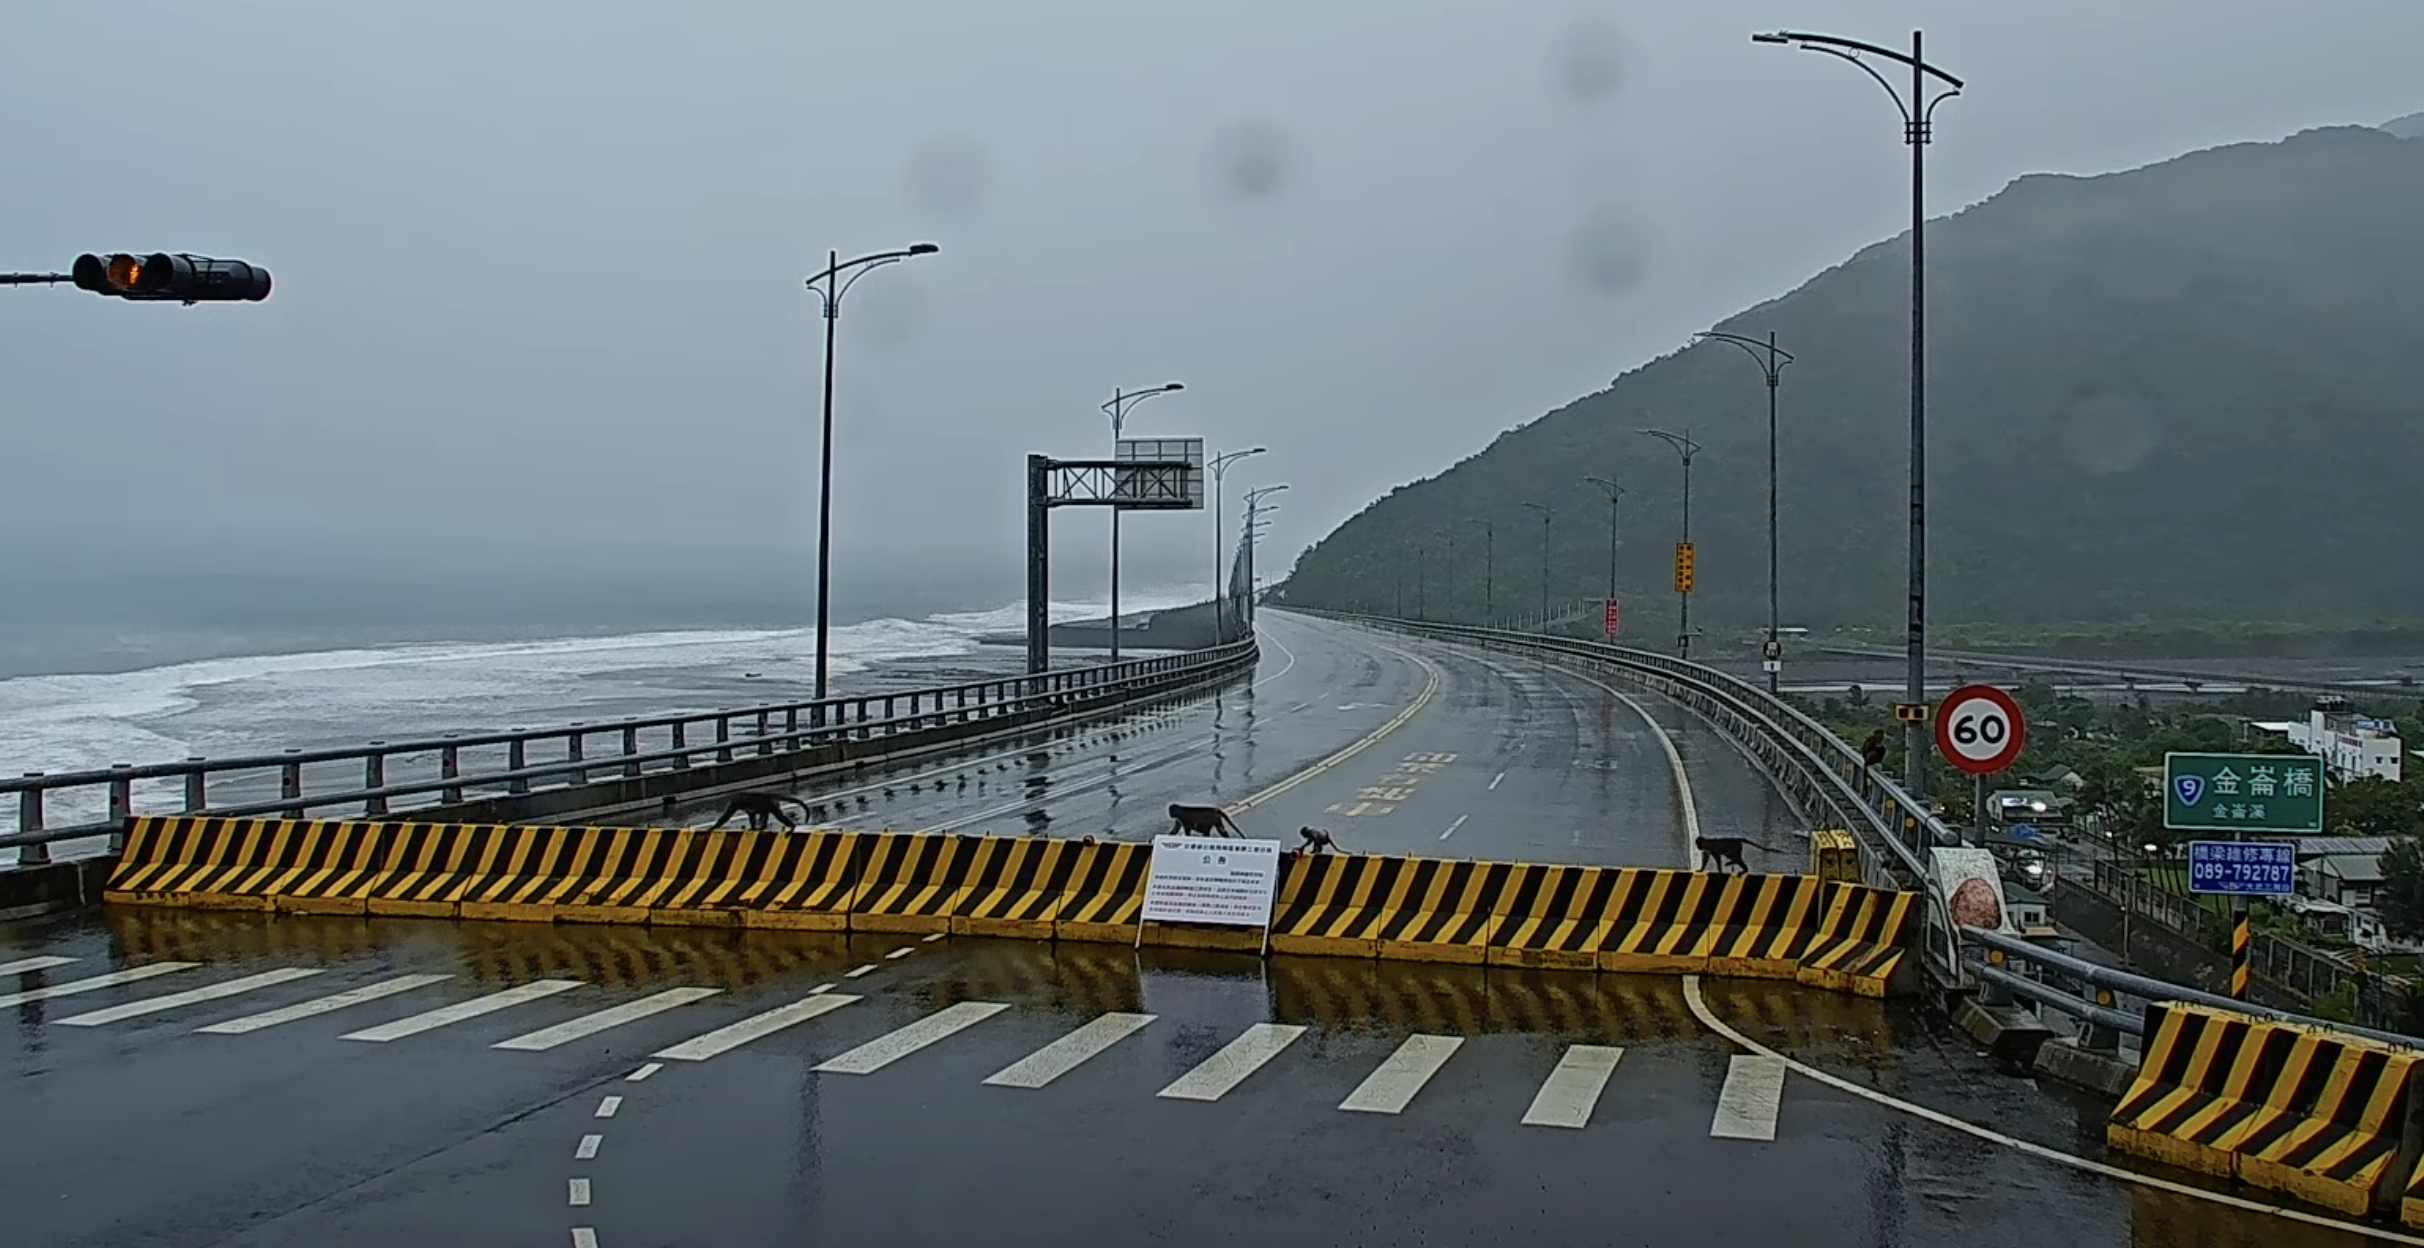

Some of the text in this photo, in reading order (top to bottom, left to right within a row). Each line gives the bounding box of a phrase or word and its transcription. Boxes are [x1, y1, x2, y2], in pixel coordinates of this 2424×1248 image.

[1954, 714, 2005, 745] 60
[2183, 780, 2196, 795] 9
[2212, 766, 2314, 797] 金崙橋
[2213, 803, 2266, 819] 金崙溪
[2194, 862, 2290, 882] 089-792787
